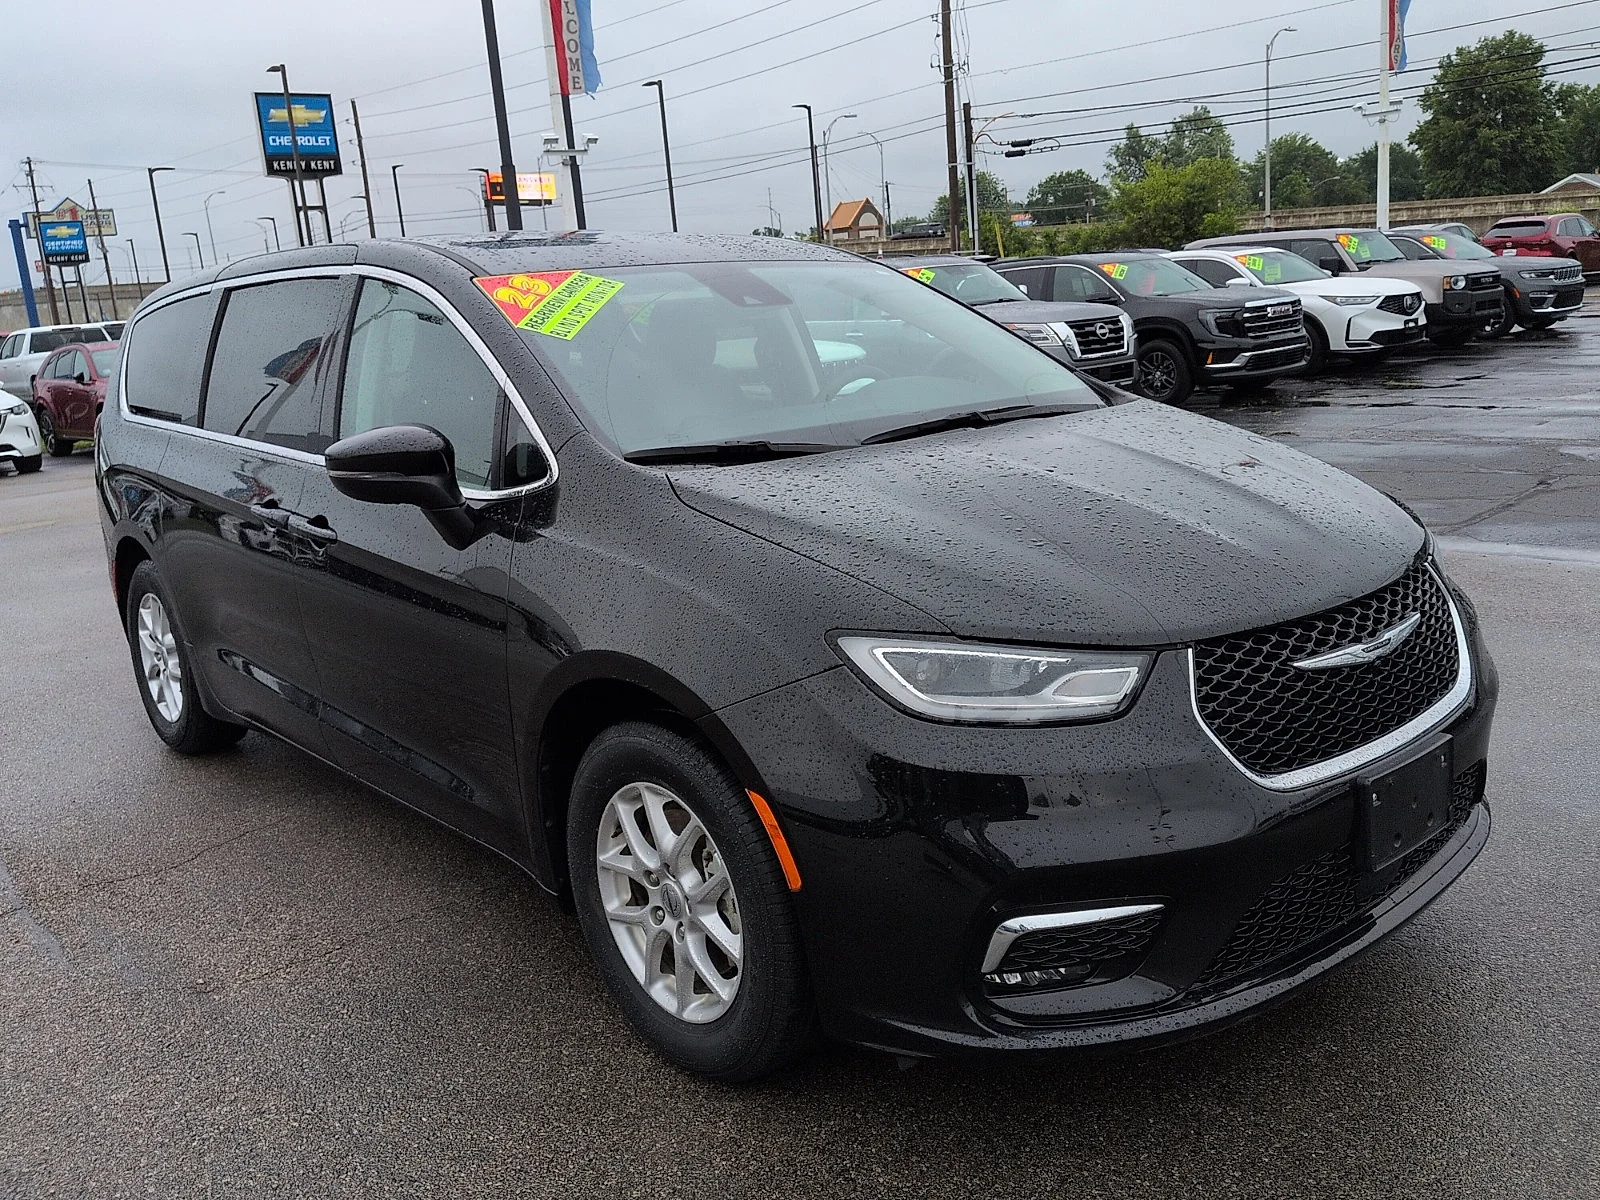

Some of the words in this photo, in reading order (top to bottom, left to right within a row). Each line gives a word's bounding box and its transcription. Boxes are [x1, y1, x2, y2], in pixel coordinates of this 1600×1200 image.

[269, 135, 331, 146] CHEROLET
[310, 160, 335, 170] KENT
[45, 239, 84, 247] CERTIFIED
[493, 275, 552, 310] 23
[524, 295, 567, 330] REARVIEW
[558, 275, 592, 298] CAMERA
[549, 317, 581, 337] BLIND
[568, 302, 594, 319] SPOT
